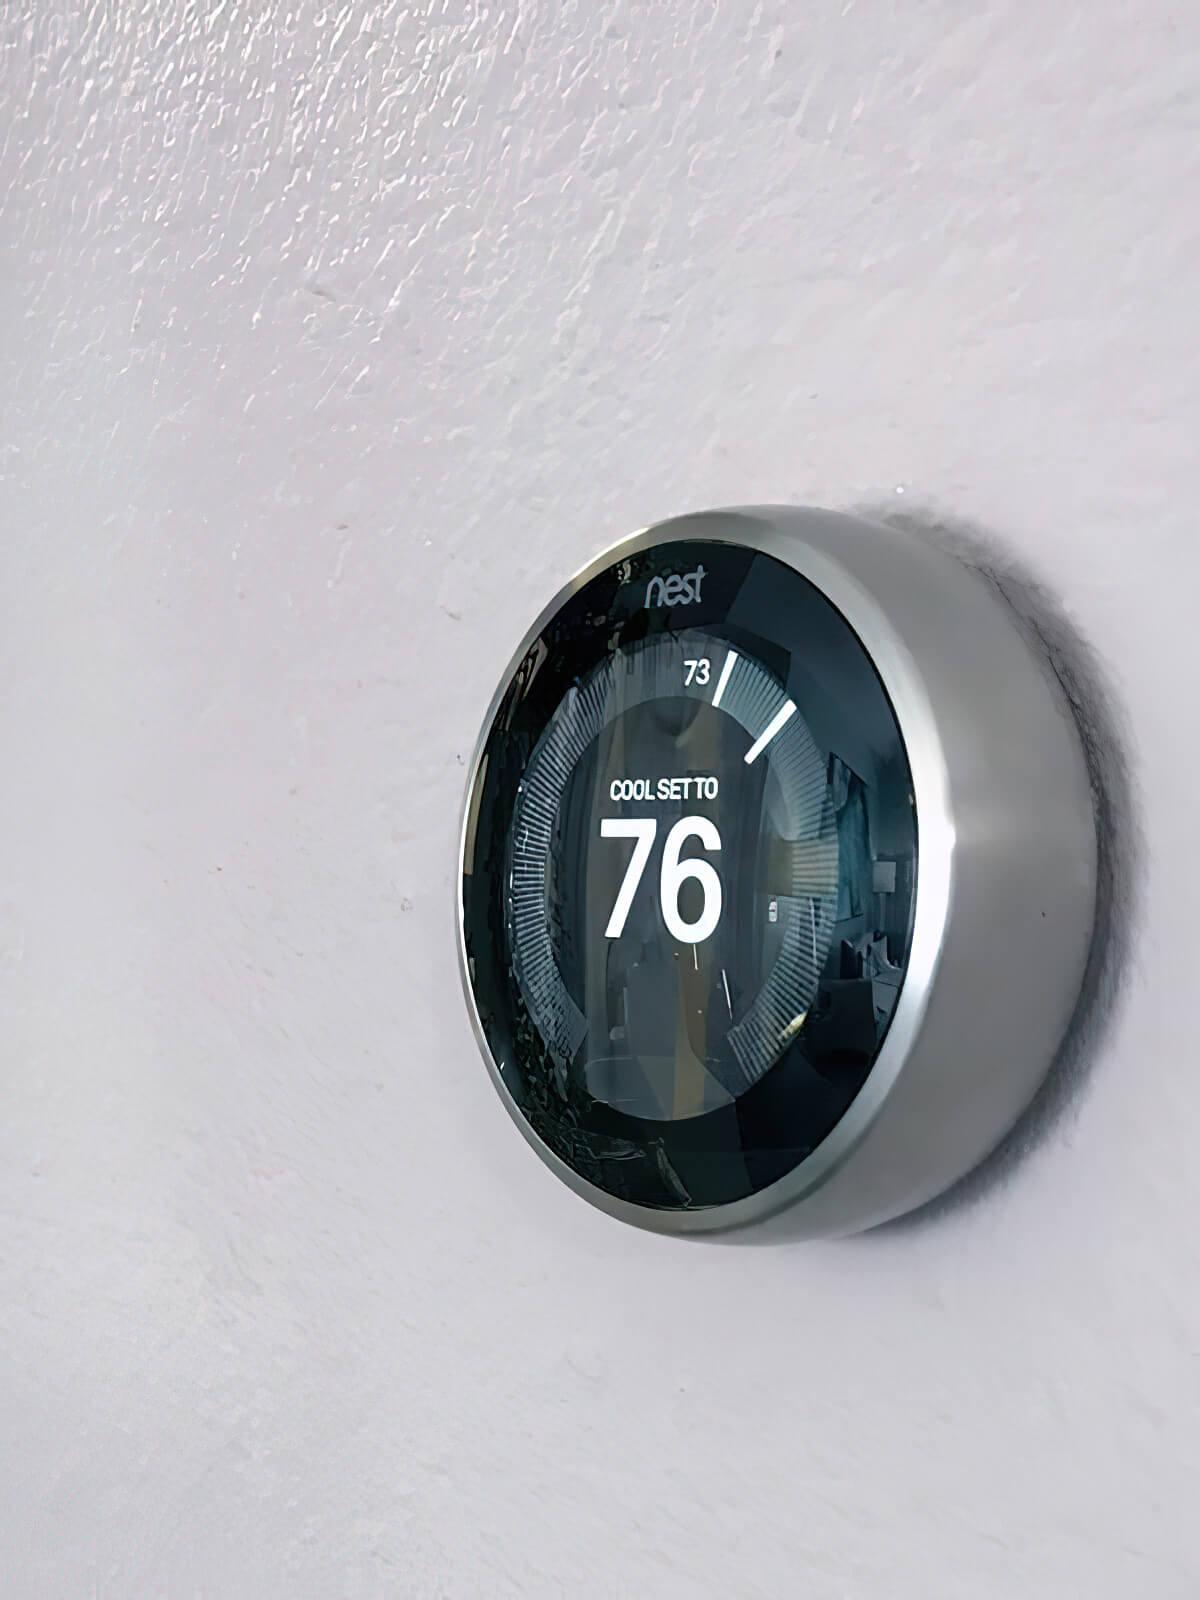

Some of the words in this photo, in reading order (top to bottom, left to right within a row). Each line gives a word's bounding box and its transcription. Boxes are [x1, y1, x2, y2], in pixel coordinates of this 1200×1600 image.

[644, 565, 708, 608] nest
[683, 658, 711, 686] 73
[610, 779, 655, 801] COOL
[657, 778, 690, 800] SET
[692, 776, 719, 800] TO
[600, 815, 722, 944] 76
